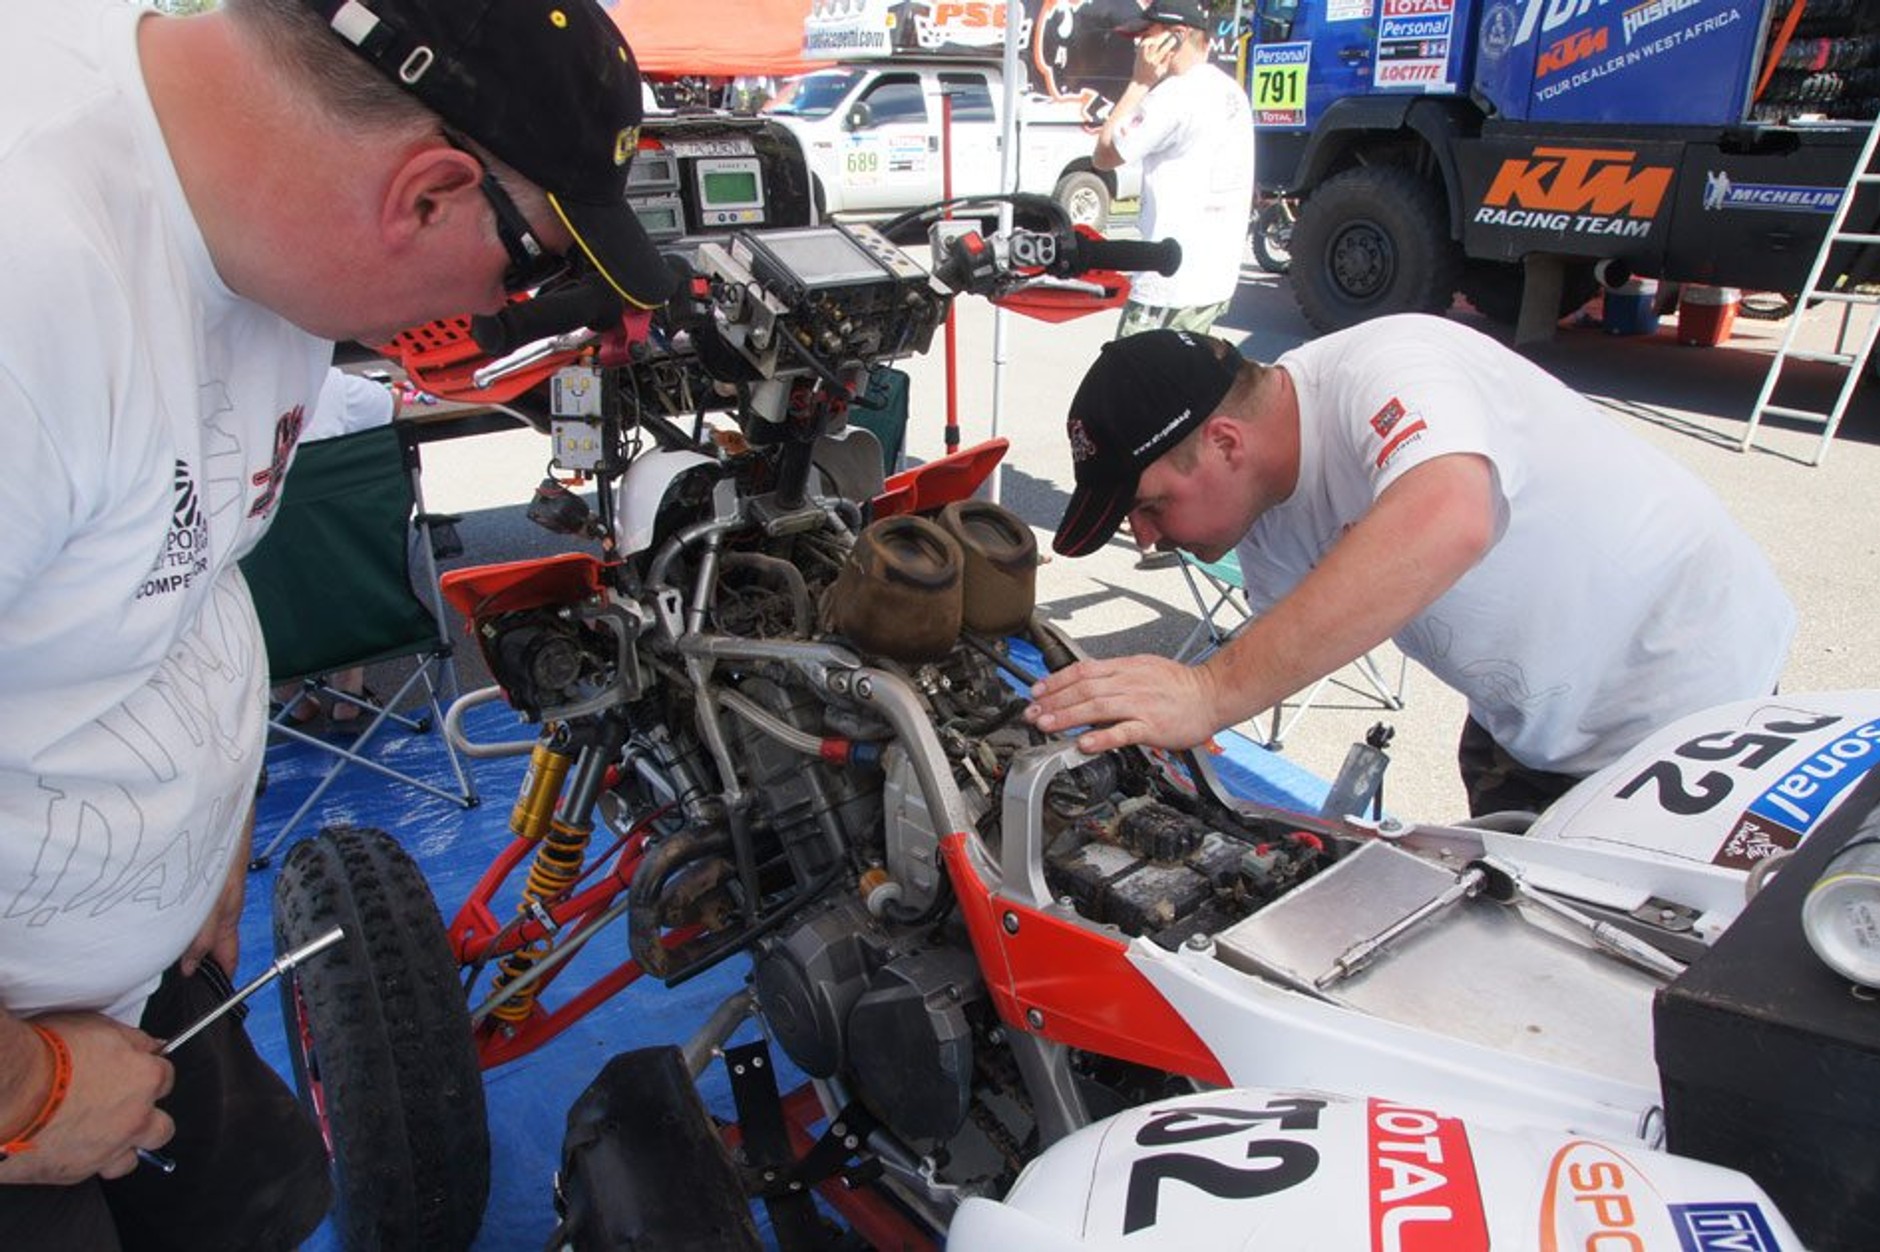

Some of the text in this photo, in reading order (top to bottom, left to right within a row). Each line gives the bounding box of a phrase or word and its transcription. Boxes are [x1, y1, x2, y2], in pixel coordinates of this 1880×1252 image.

[1388, 0, 1450, 13] TOTAL
[1383, 17, 1448, 36] Personal
[1257, 46, 1307, 63] Personal
[1536, 27, 1609, 78] KTM
[1536, 8, 1741, 101] YOUR DEALER IN WEST AFRICA
[1380, 64, 1440, 81] LOCTITE
[1259, 70, 1298, 103] 791
[847, 152, 878, 172] 689
[1483, 147, 1675, 218] KTM
[1729, 187, 1842, 208] MICHELIN
[1474, 207, 1651, 237] RACING TEAM
[1375, 1101, 1454, 1252] OTAL
